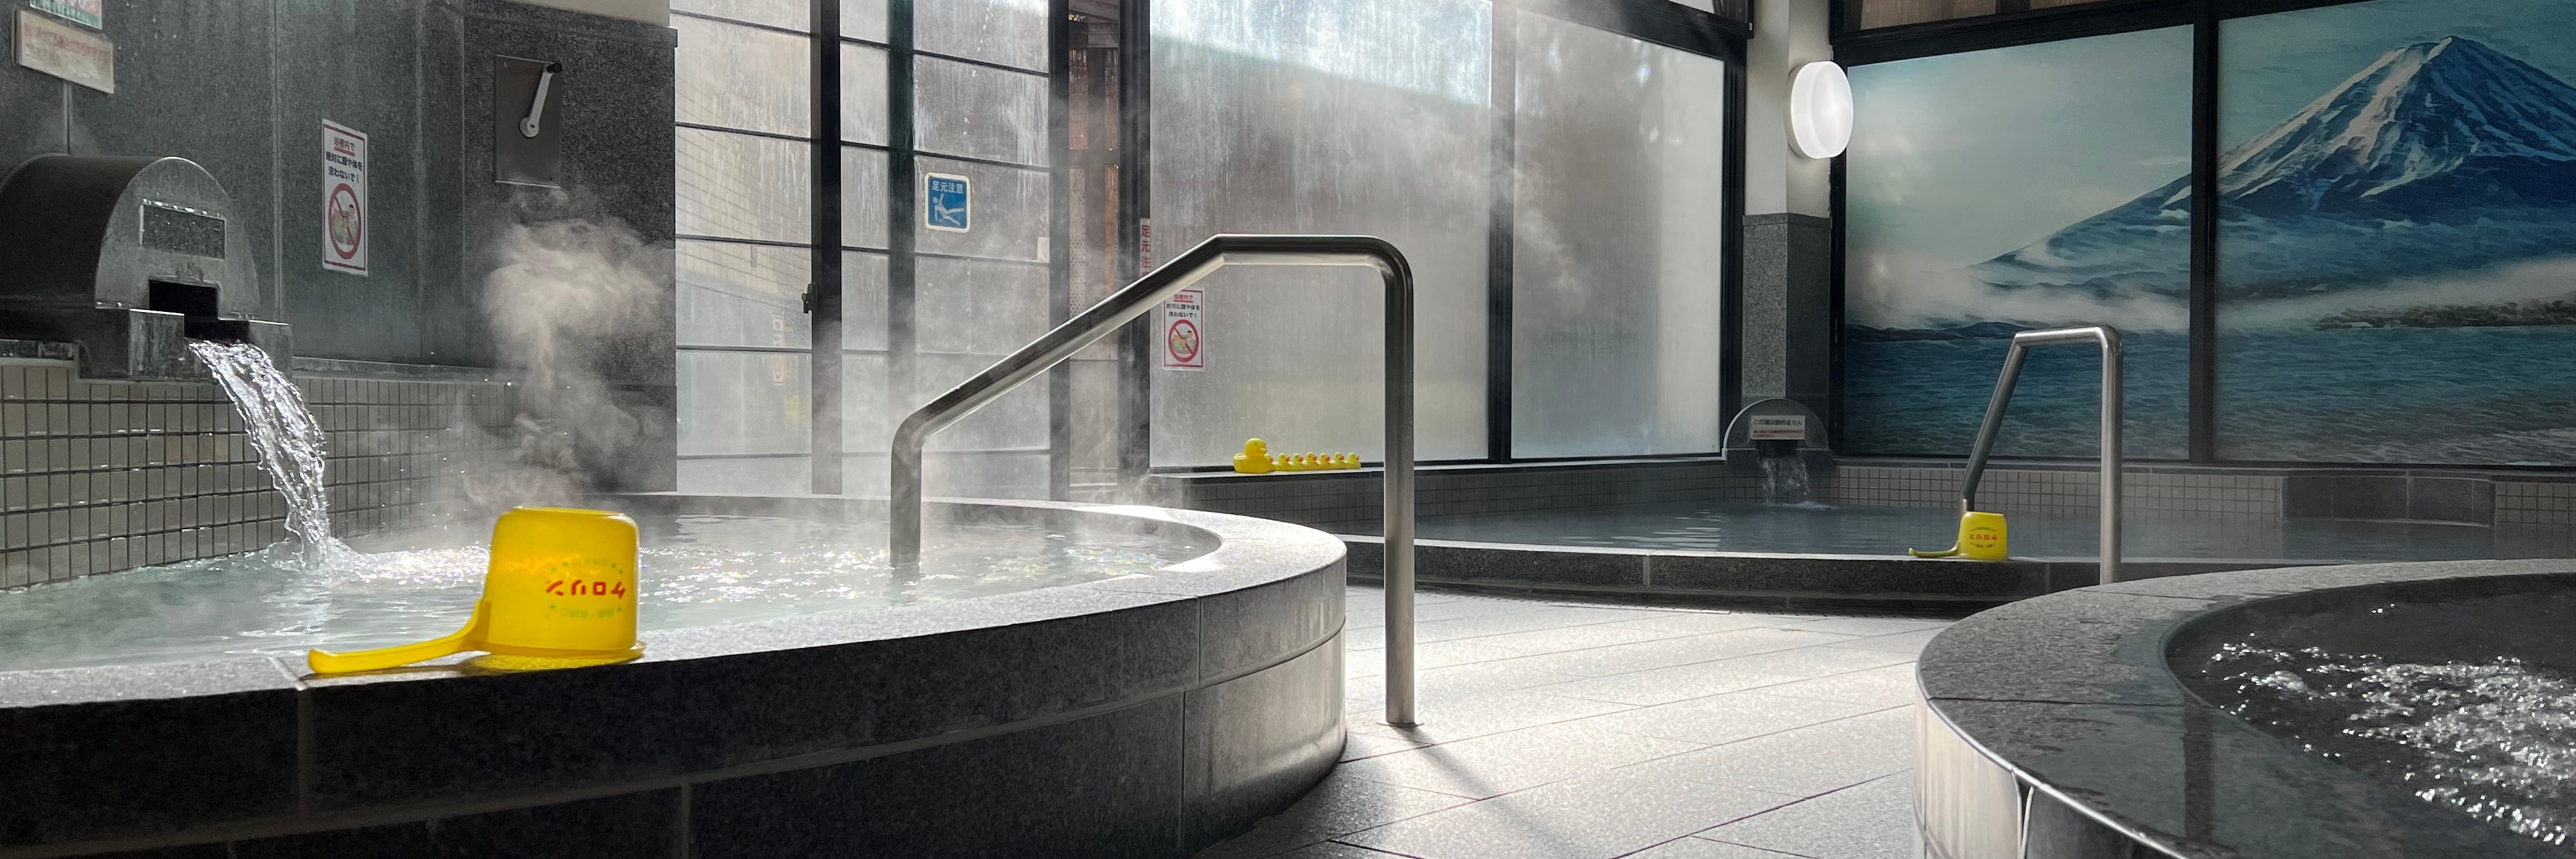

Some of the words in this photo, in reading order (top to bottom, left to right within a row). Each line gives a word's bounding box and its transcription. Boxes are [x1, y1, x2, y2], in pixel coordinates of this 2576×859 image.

[931, 180, 963, 194] 足元注意
[1141, 224, 1151, 277] 足元注
[545, 579, 626, 600] ケロリン
